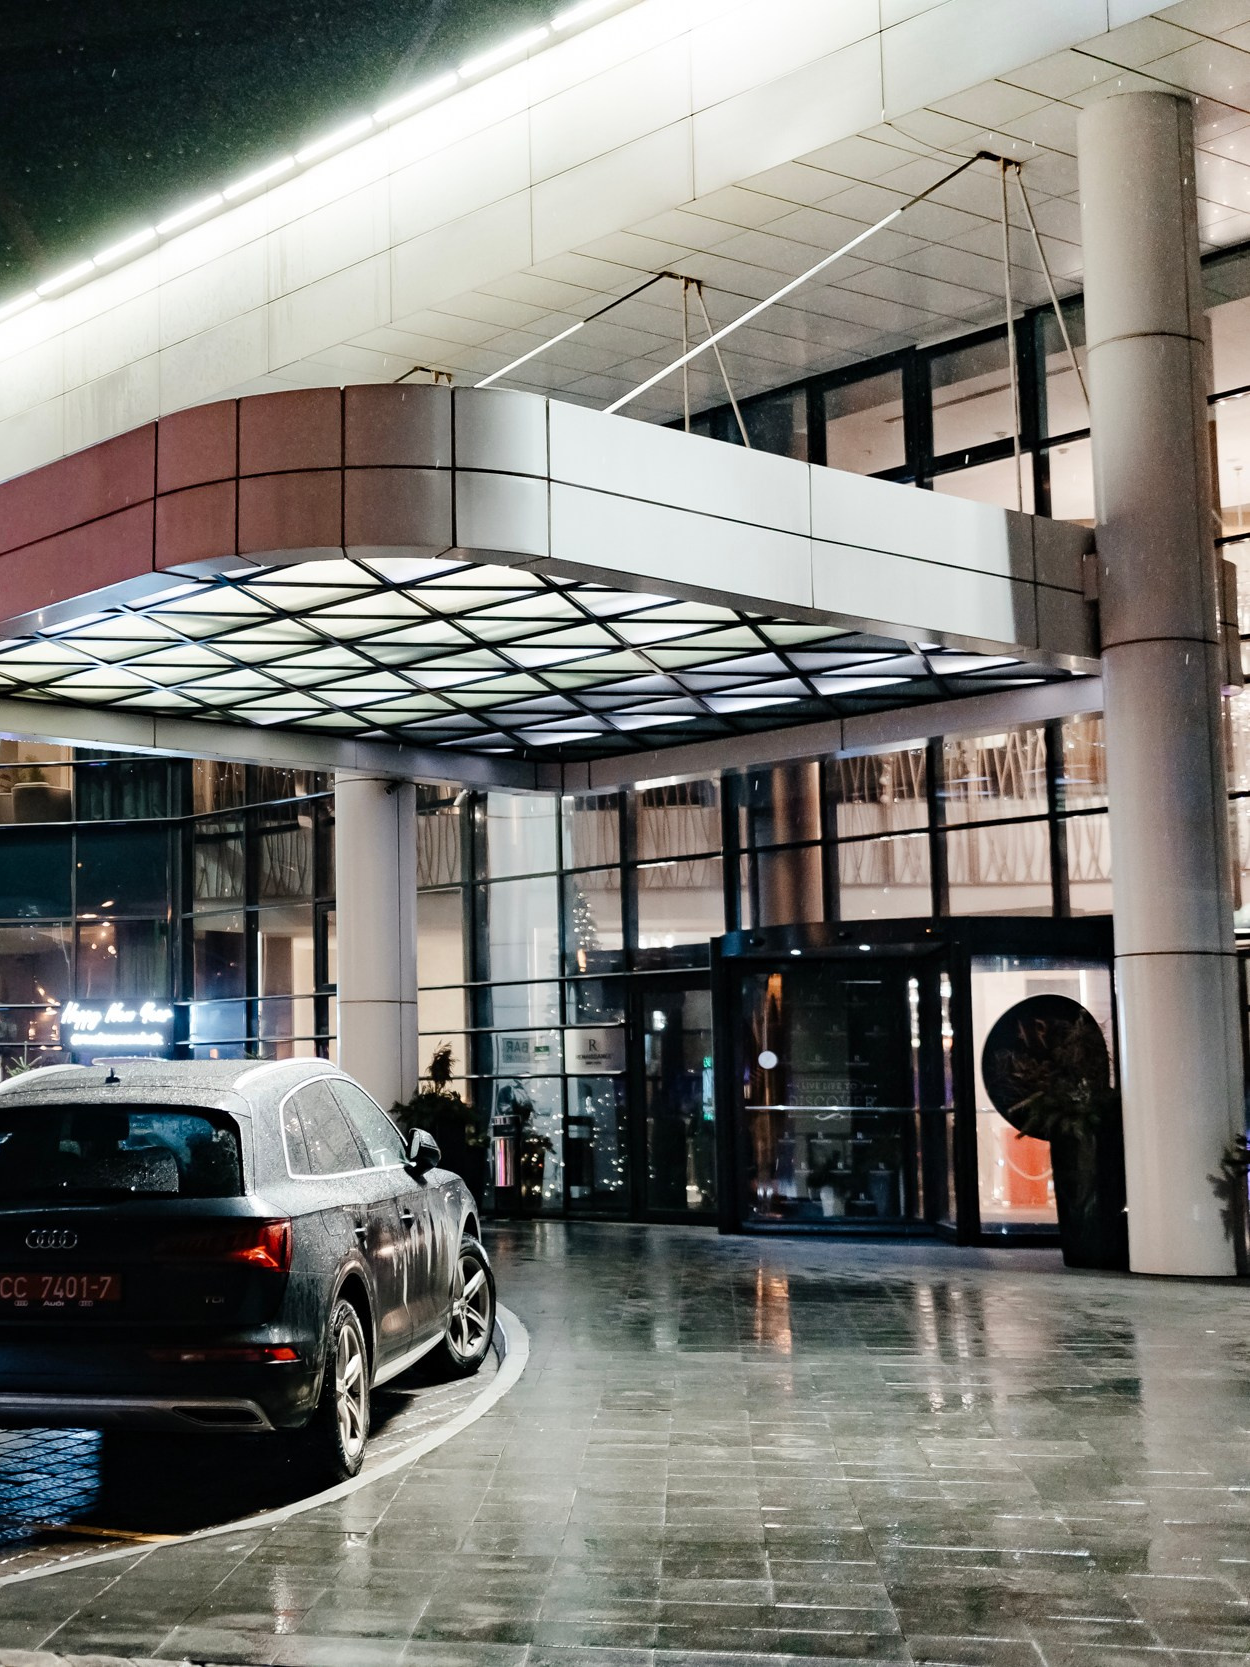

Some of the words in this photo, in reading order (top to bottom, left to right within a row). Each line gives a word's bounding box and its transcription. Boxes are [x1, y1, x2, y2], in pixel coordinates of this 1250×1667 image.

[588, 1039, 599, 1051] R
[788, 1095, 875, 1107] DISCOVER
[0, 1276, 29, 1299] CC
[40, 1276, 113, 1299] 7401-7
